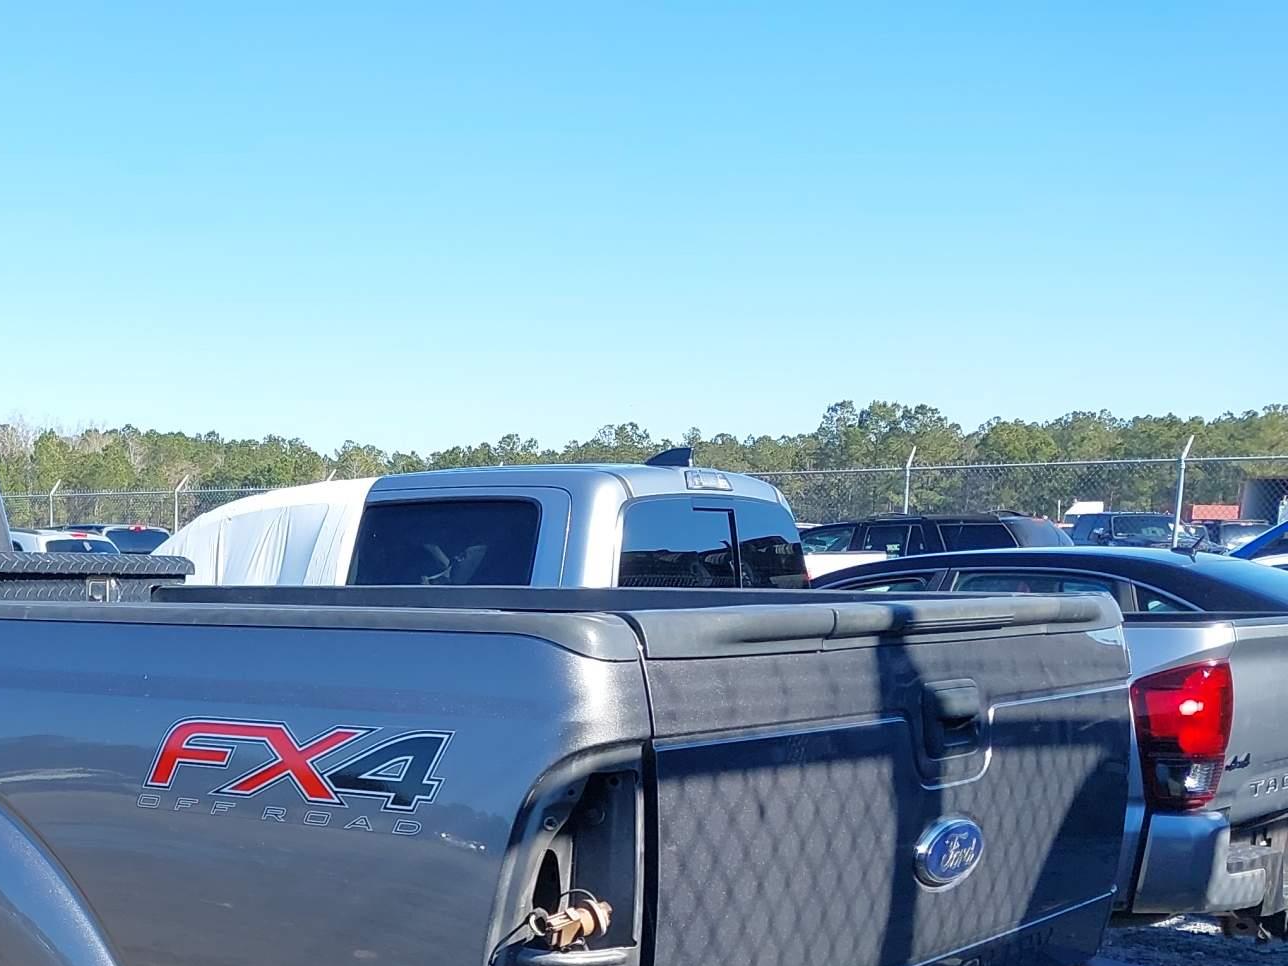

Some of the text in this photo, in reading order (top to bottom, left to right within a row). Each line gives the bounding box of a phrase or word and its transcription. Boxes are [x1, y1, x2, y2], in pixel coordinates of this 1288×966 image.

[142, 715, 457, 814] FX4
[136, 793, 424, 836] OFF ROAD
[940, 831, 977, 872] Ford
